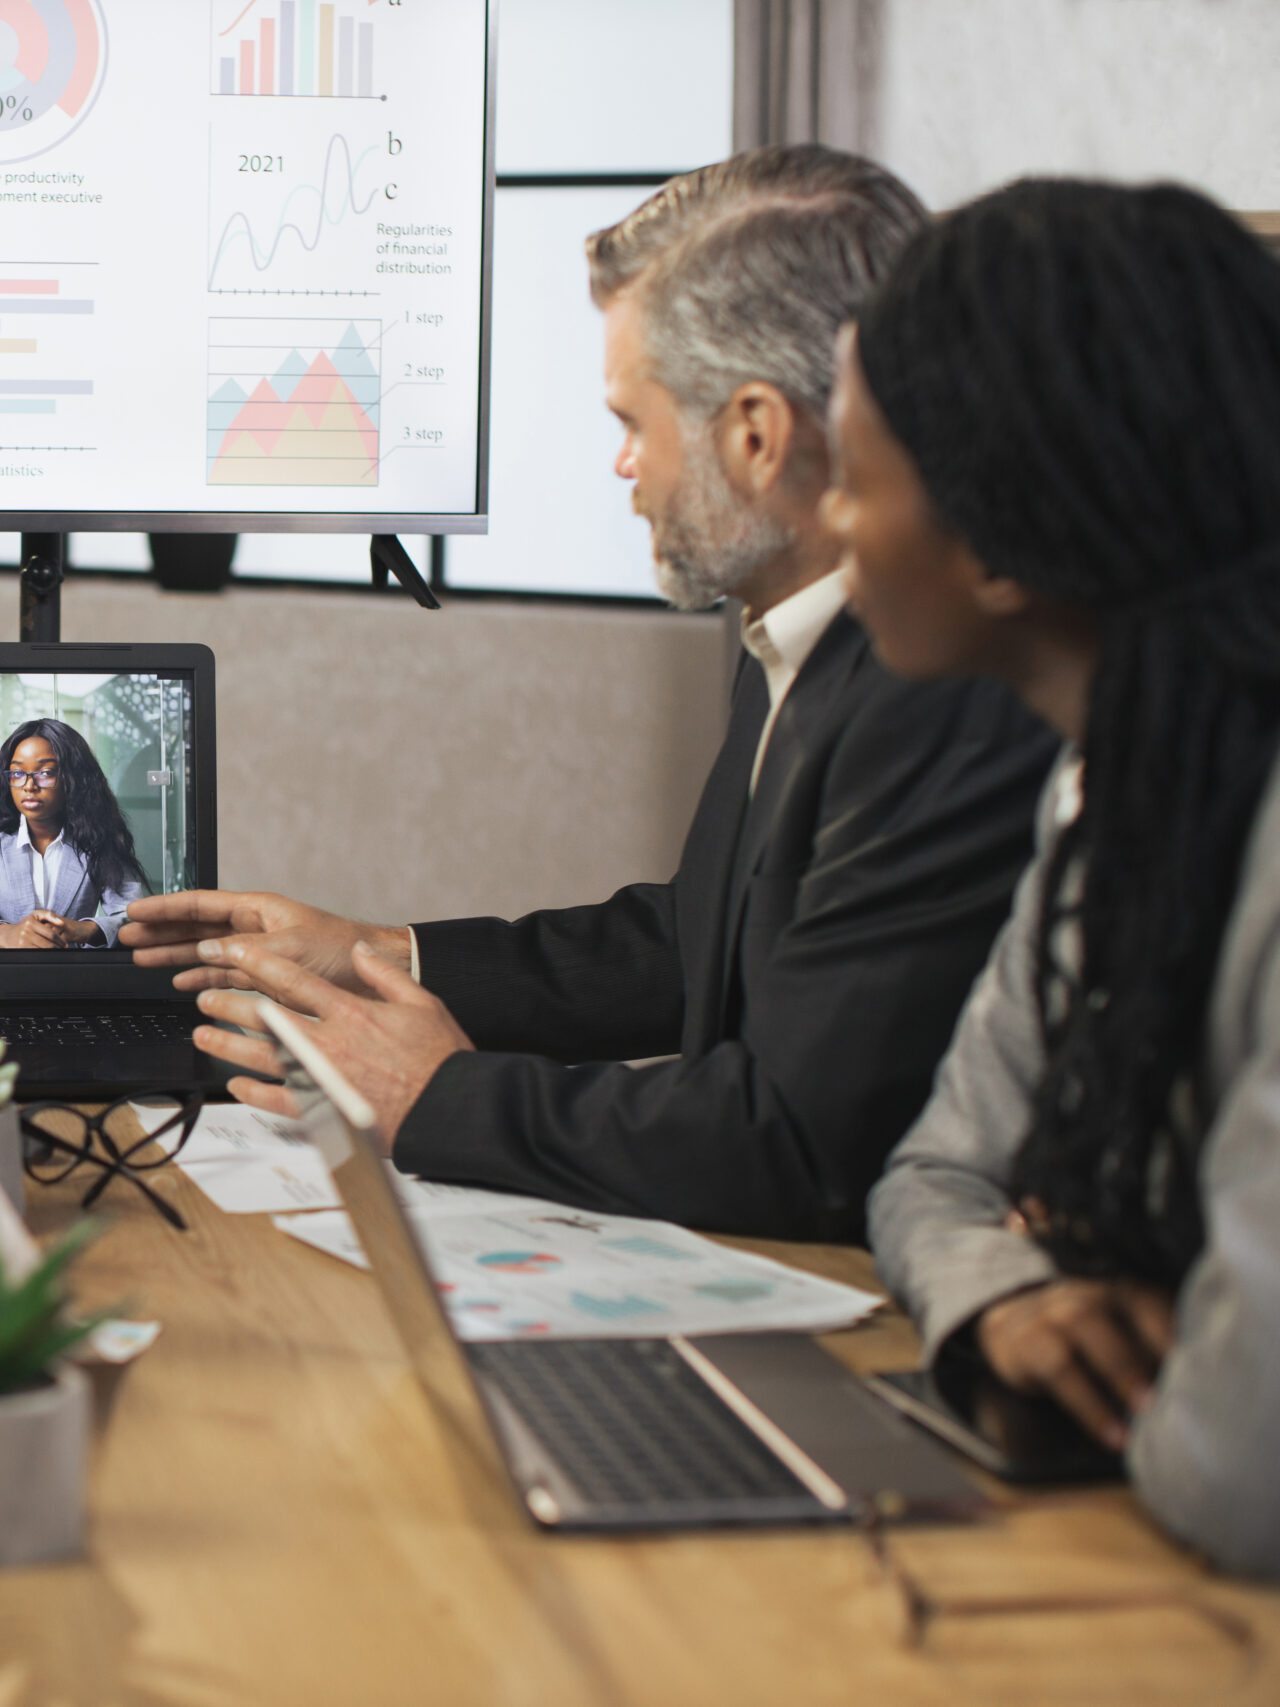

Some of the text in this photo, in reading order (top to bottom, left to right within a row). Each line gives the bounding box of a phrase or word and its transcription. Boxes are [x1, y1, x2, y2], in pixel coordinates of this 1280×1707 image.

[388, 131, 403, 156] b
[238, 154, 285, 173] 2021
[5, 171, 85, 187] productivity
[41, 191, 103, 204] executive
[384, 182, 398, 200] c
[376, 222, 454, 238] Regularities
[376, 241, 448, 255] of financial
[375, 261, 452, 274] distribution
[404, 310, 444, 327] 1 step
[404, 363, 444, 381] 2 step
[404, 426, 443, 443] 3 step
